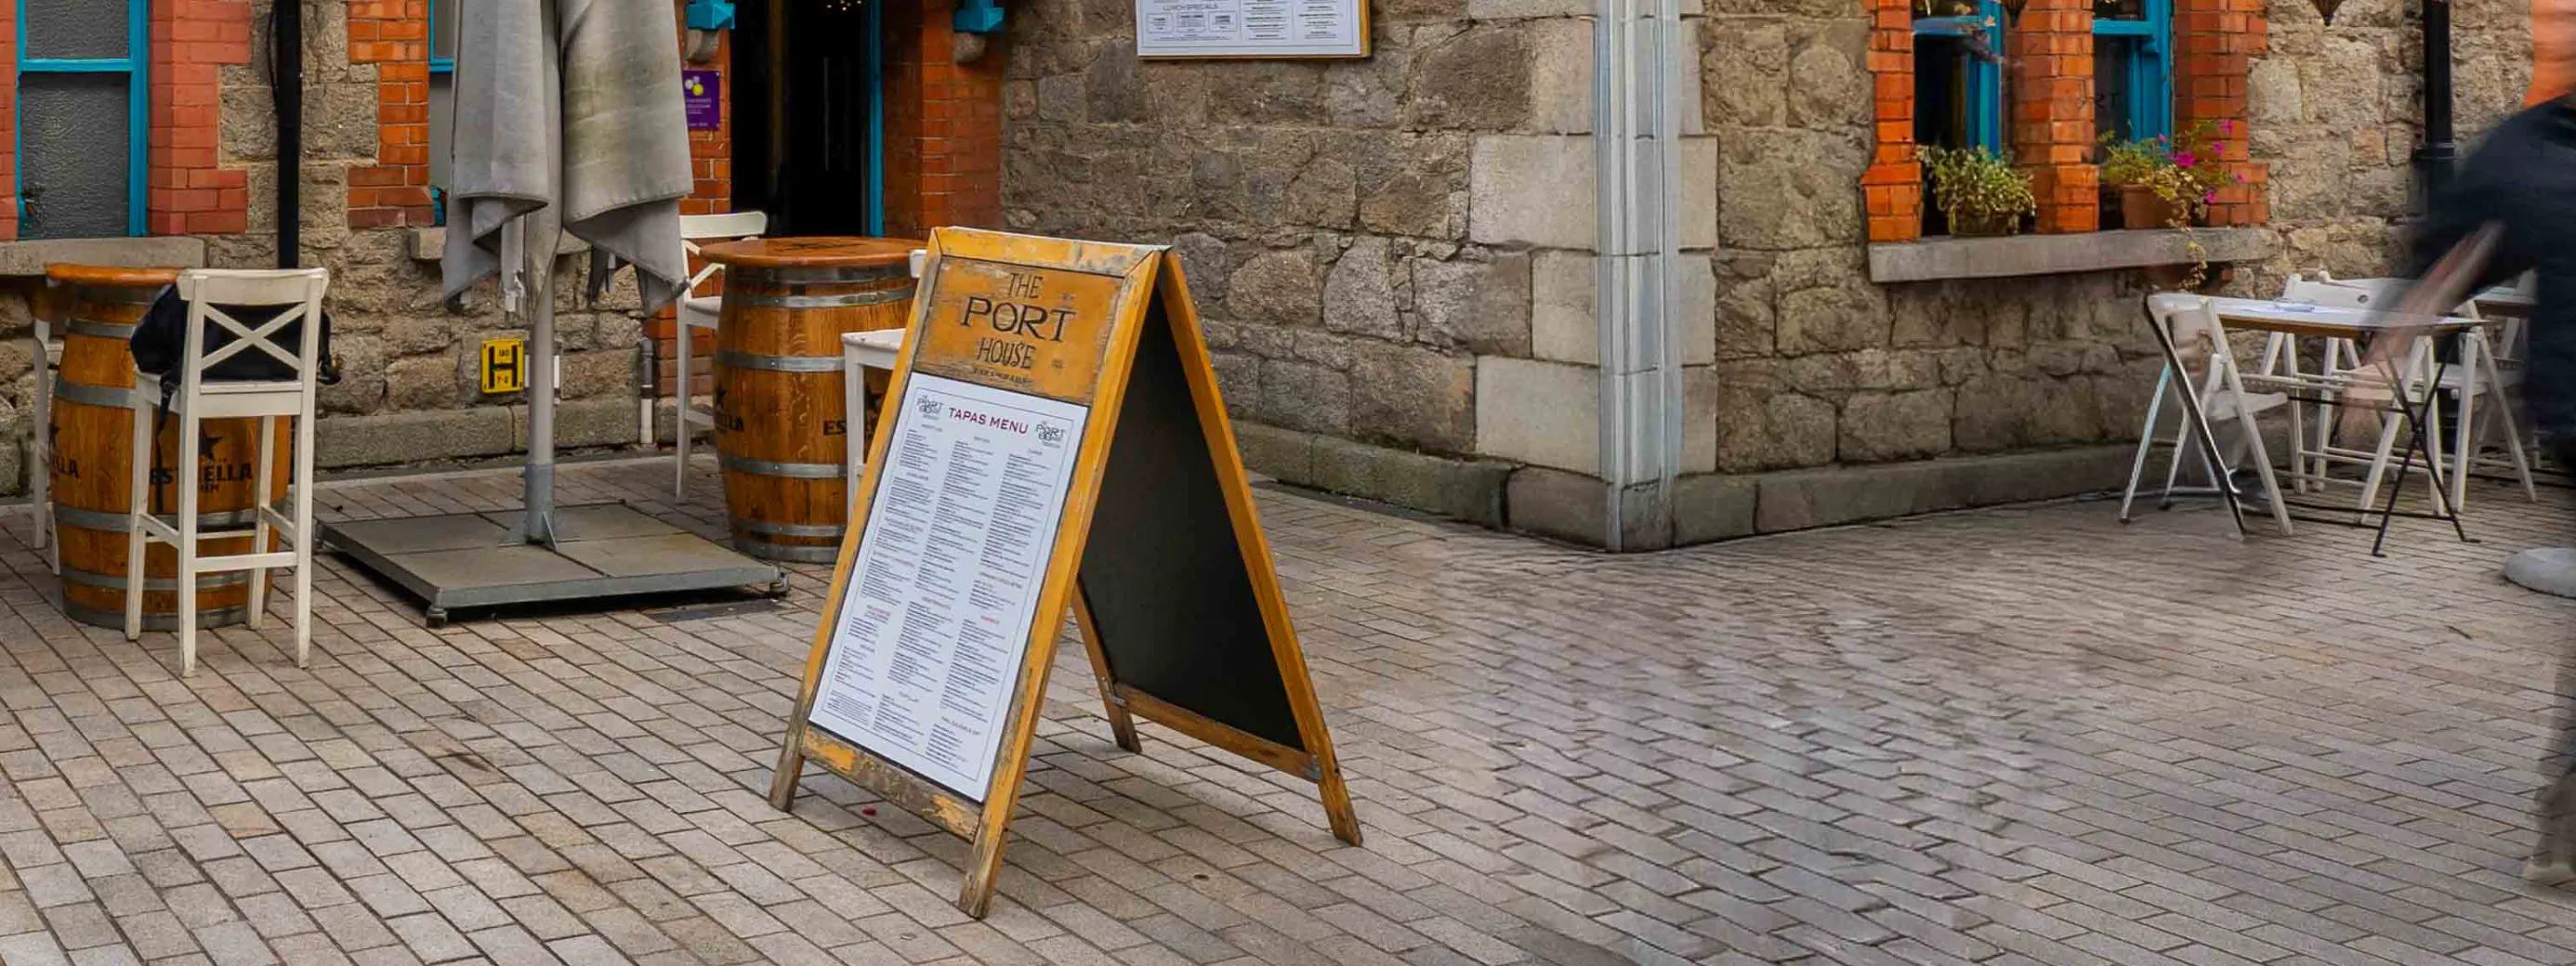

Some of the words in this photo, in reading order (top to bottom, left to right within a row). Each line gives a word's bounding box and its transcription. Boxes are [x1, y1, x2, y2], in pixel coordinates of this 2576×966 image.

[1008, 273, 1044, 299] THE
[960, 296, 1077, 343] PORT
[489, 345, 518, 388] H
[977, 337, 1037, 369] HOUSE
[948, 407, 987, 425] TAPAS
[989, 417, 1029, 435] MENU
[1035, 424, 1066, 437] PORT
[150, 463, 253, 484] ESELLA
